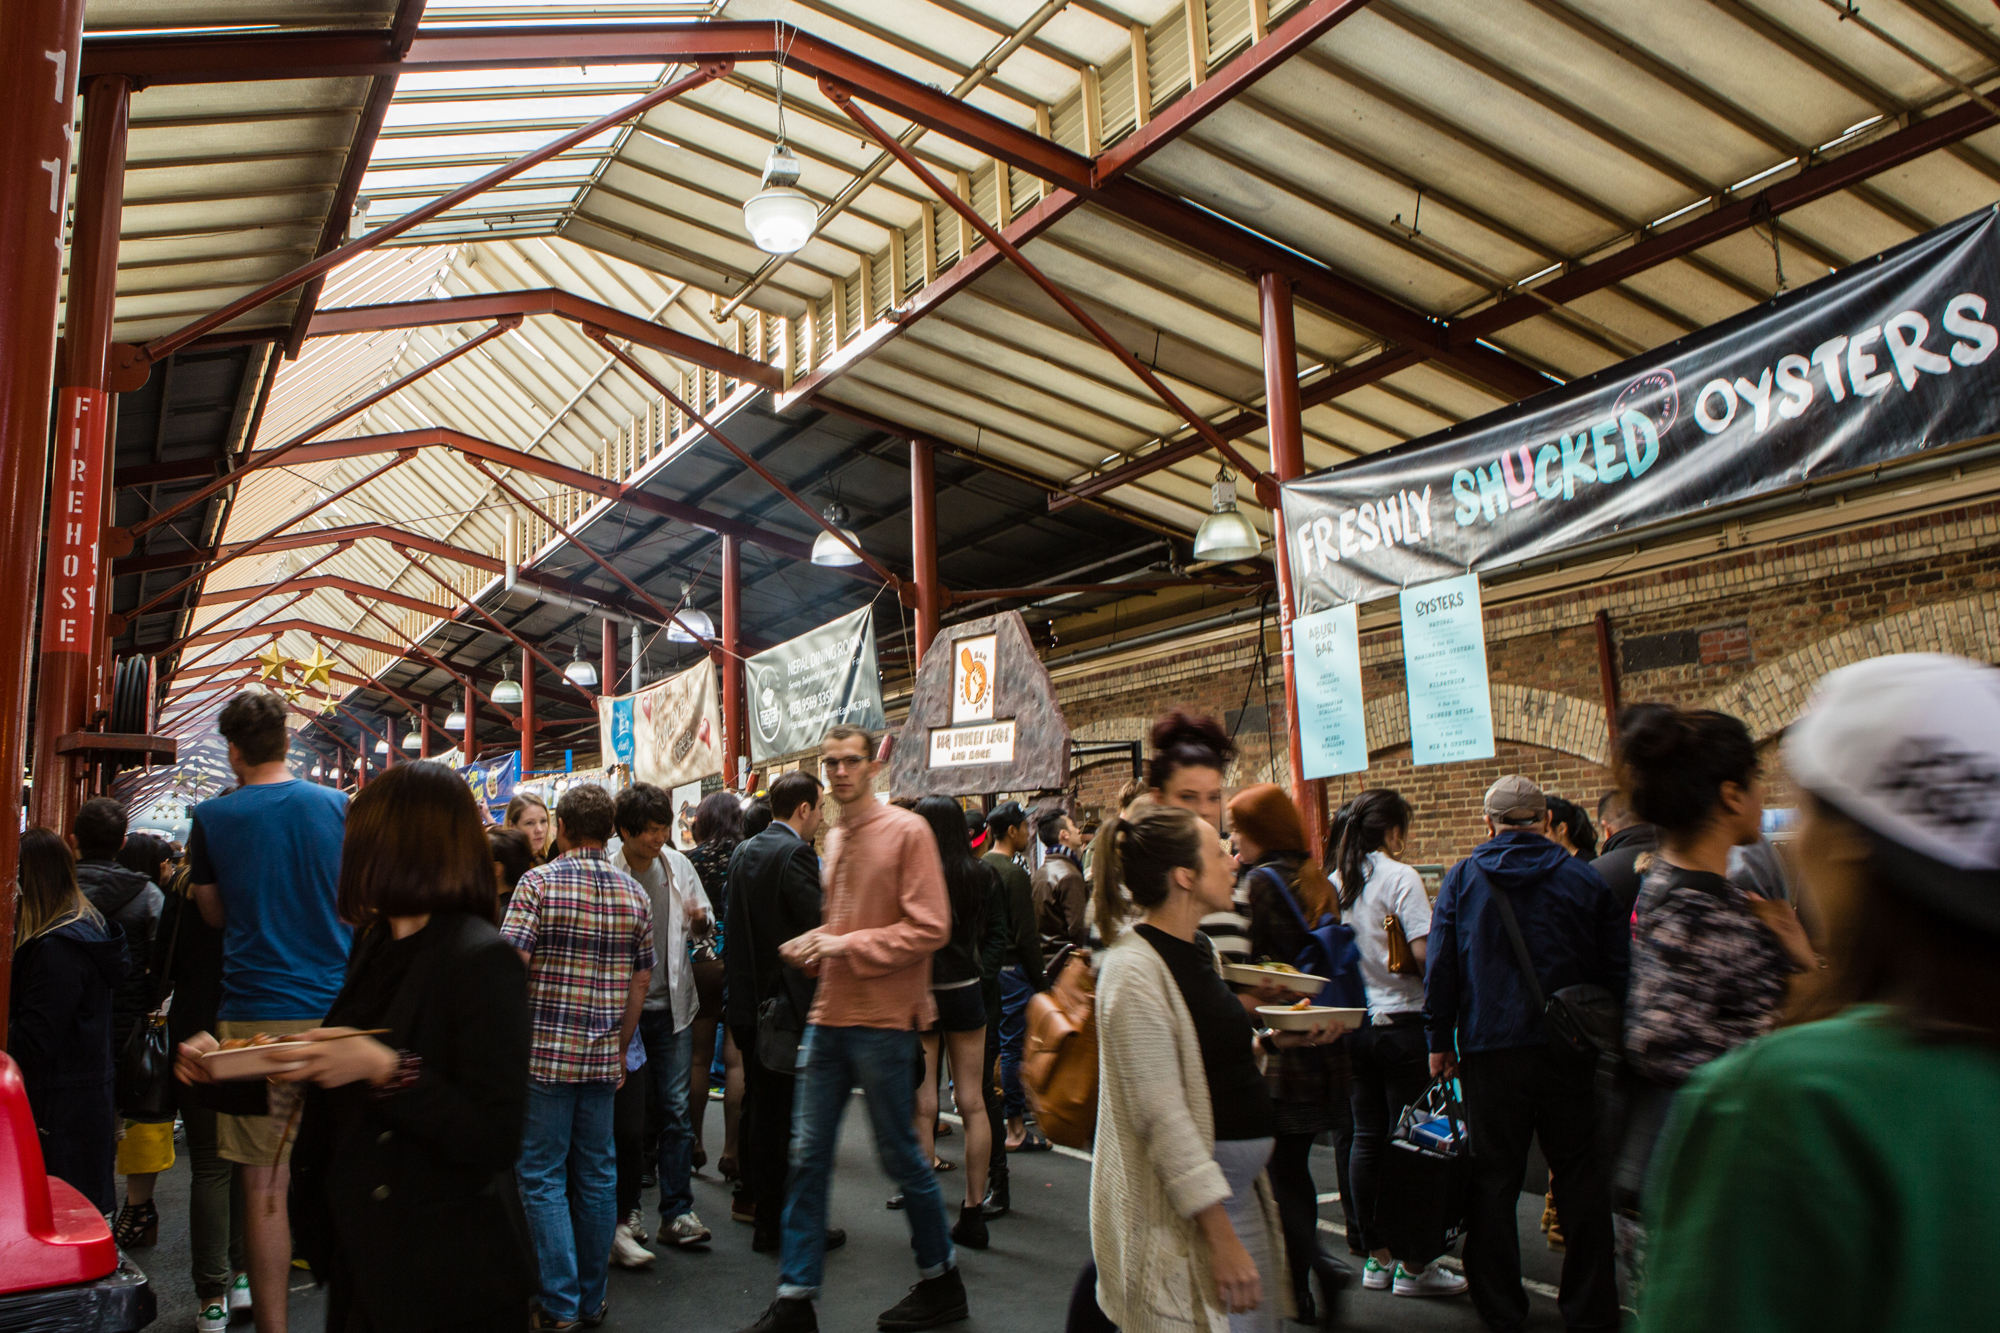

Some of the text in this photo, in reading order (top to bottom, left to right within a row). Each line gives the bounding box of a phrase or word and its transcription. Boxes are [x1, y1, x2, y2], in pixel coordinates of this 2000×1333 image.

[1297, 293, 1999, 577] FRESHLY SHUCKED OYSTERS
[1415, 590, 1465, 618] OYSTERS
[1429, 617, 1454, 628] NATURAL
[1308, 621, 1337, 641] ABURI
[1315, 640, 1334, 658] BAR
[1414, 643, 1476, 662] MARINATED OYSTERS
[788, 656, 810, 677] NEPAL
[810, 644, 837, 668] DINING
[1316, 676, 1340, 687] SCALLOPS
[1428, 677, 1465, 690] KILPATRICK
[802, 693, 817, 712] 9569
[817, 688, 834, 708] 3358
[760, 702, 780, 727] nepal
[1318, 705, 1342, 716] SCALLOPS
[1426, 706, 1474, 721] CHINESE STYLE
[936, 726, 1011, 751] BBQ TURKEY LEGS
[1321, 739, 1345, 749] SCALLOPS
[1325, 734, 1341, 743] MIXED
[1428, 743, 1440, 751] MIX
[1450, 738, 1477, 748] OYSTERS
[951, 748, 991, 762] AND MORE
